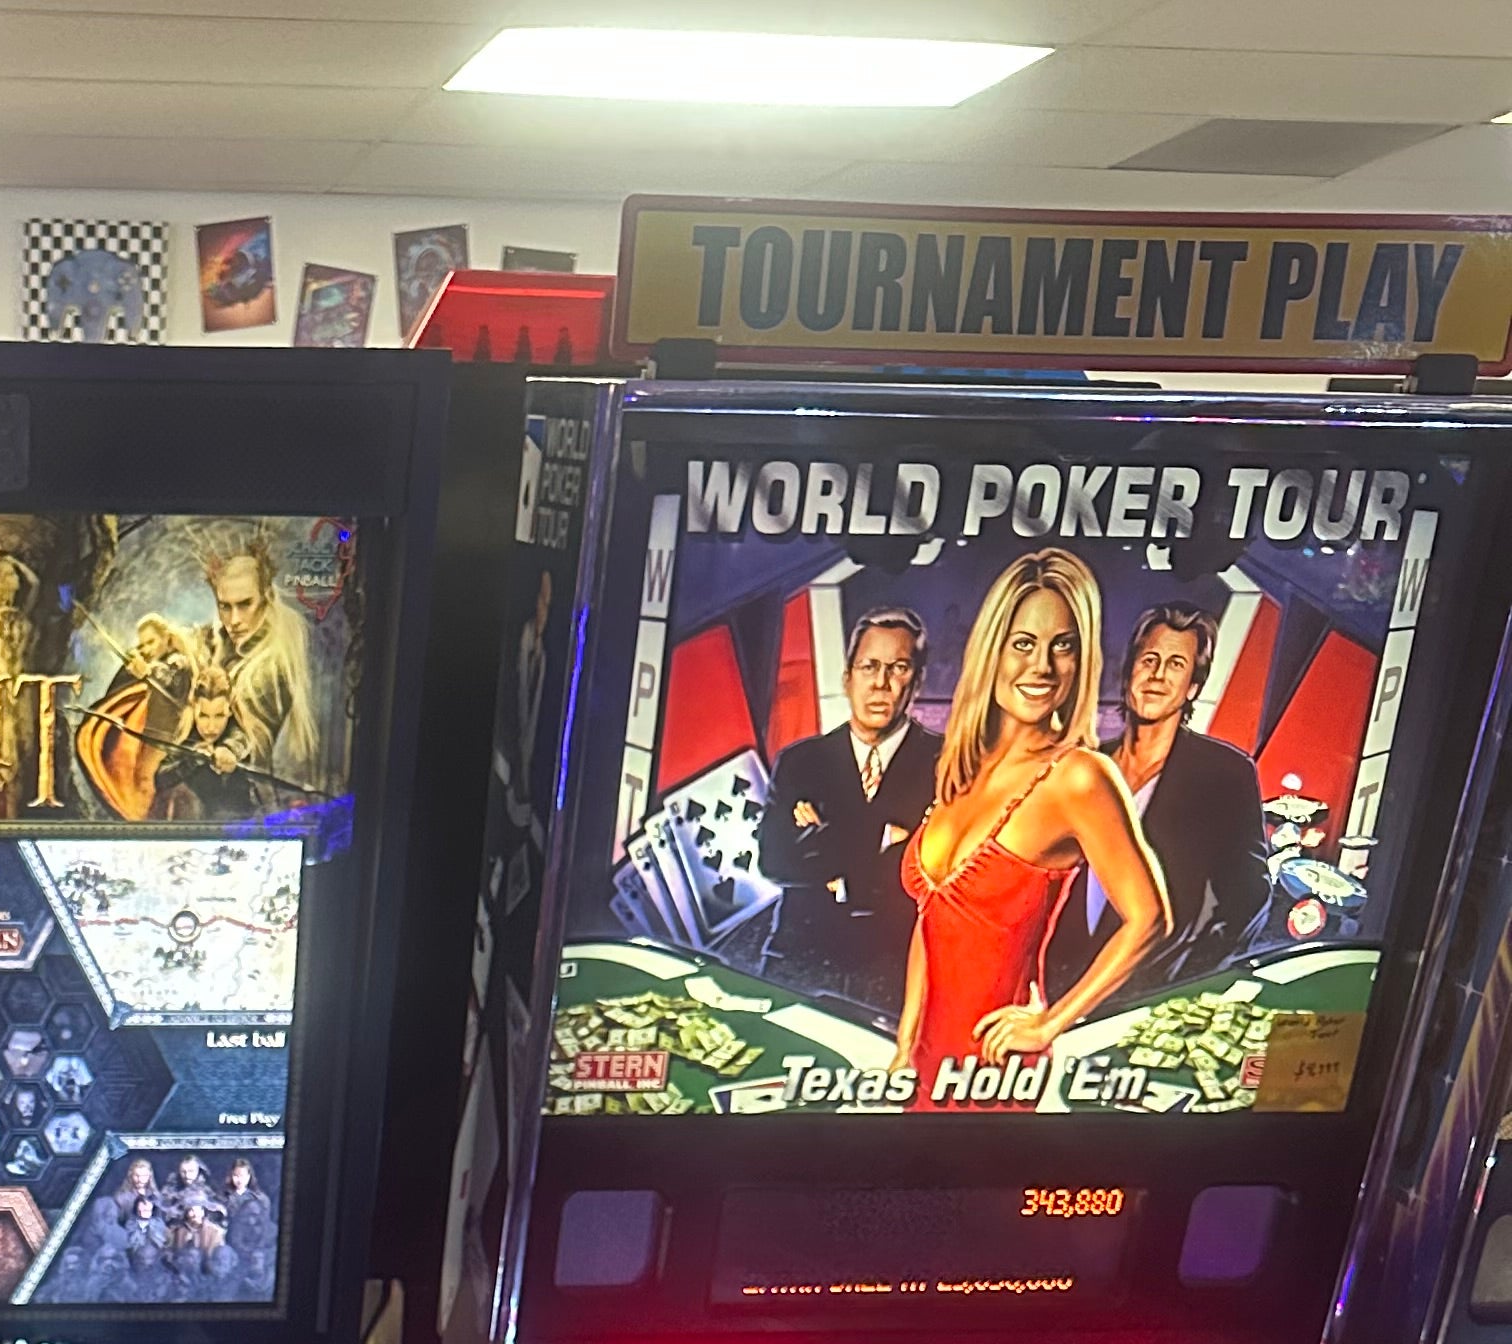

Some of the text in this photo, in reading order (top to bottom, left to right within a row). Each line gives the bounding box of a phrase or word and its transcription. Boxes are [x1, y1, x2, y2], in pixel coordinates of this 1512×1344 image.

[691, 225, 1465, 344] TOURNAMENT PLAY
[688, 460, 1411, 541] WORLD POKER TOUR
[575, 1054, 665, 1079] STERN
[782, 1055, 920, 1103] Texas
[930, 1054, 1050, 1103] Hold
[1020, 1188, 1125, 1219] 343,880
